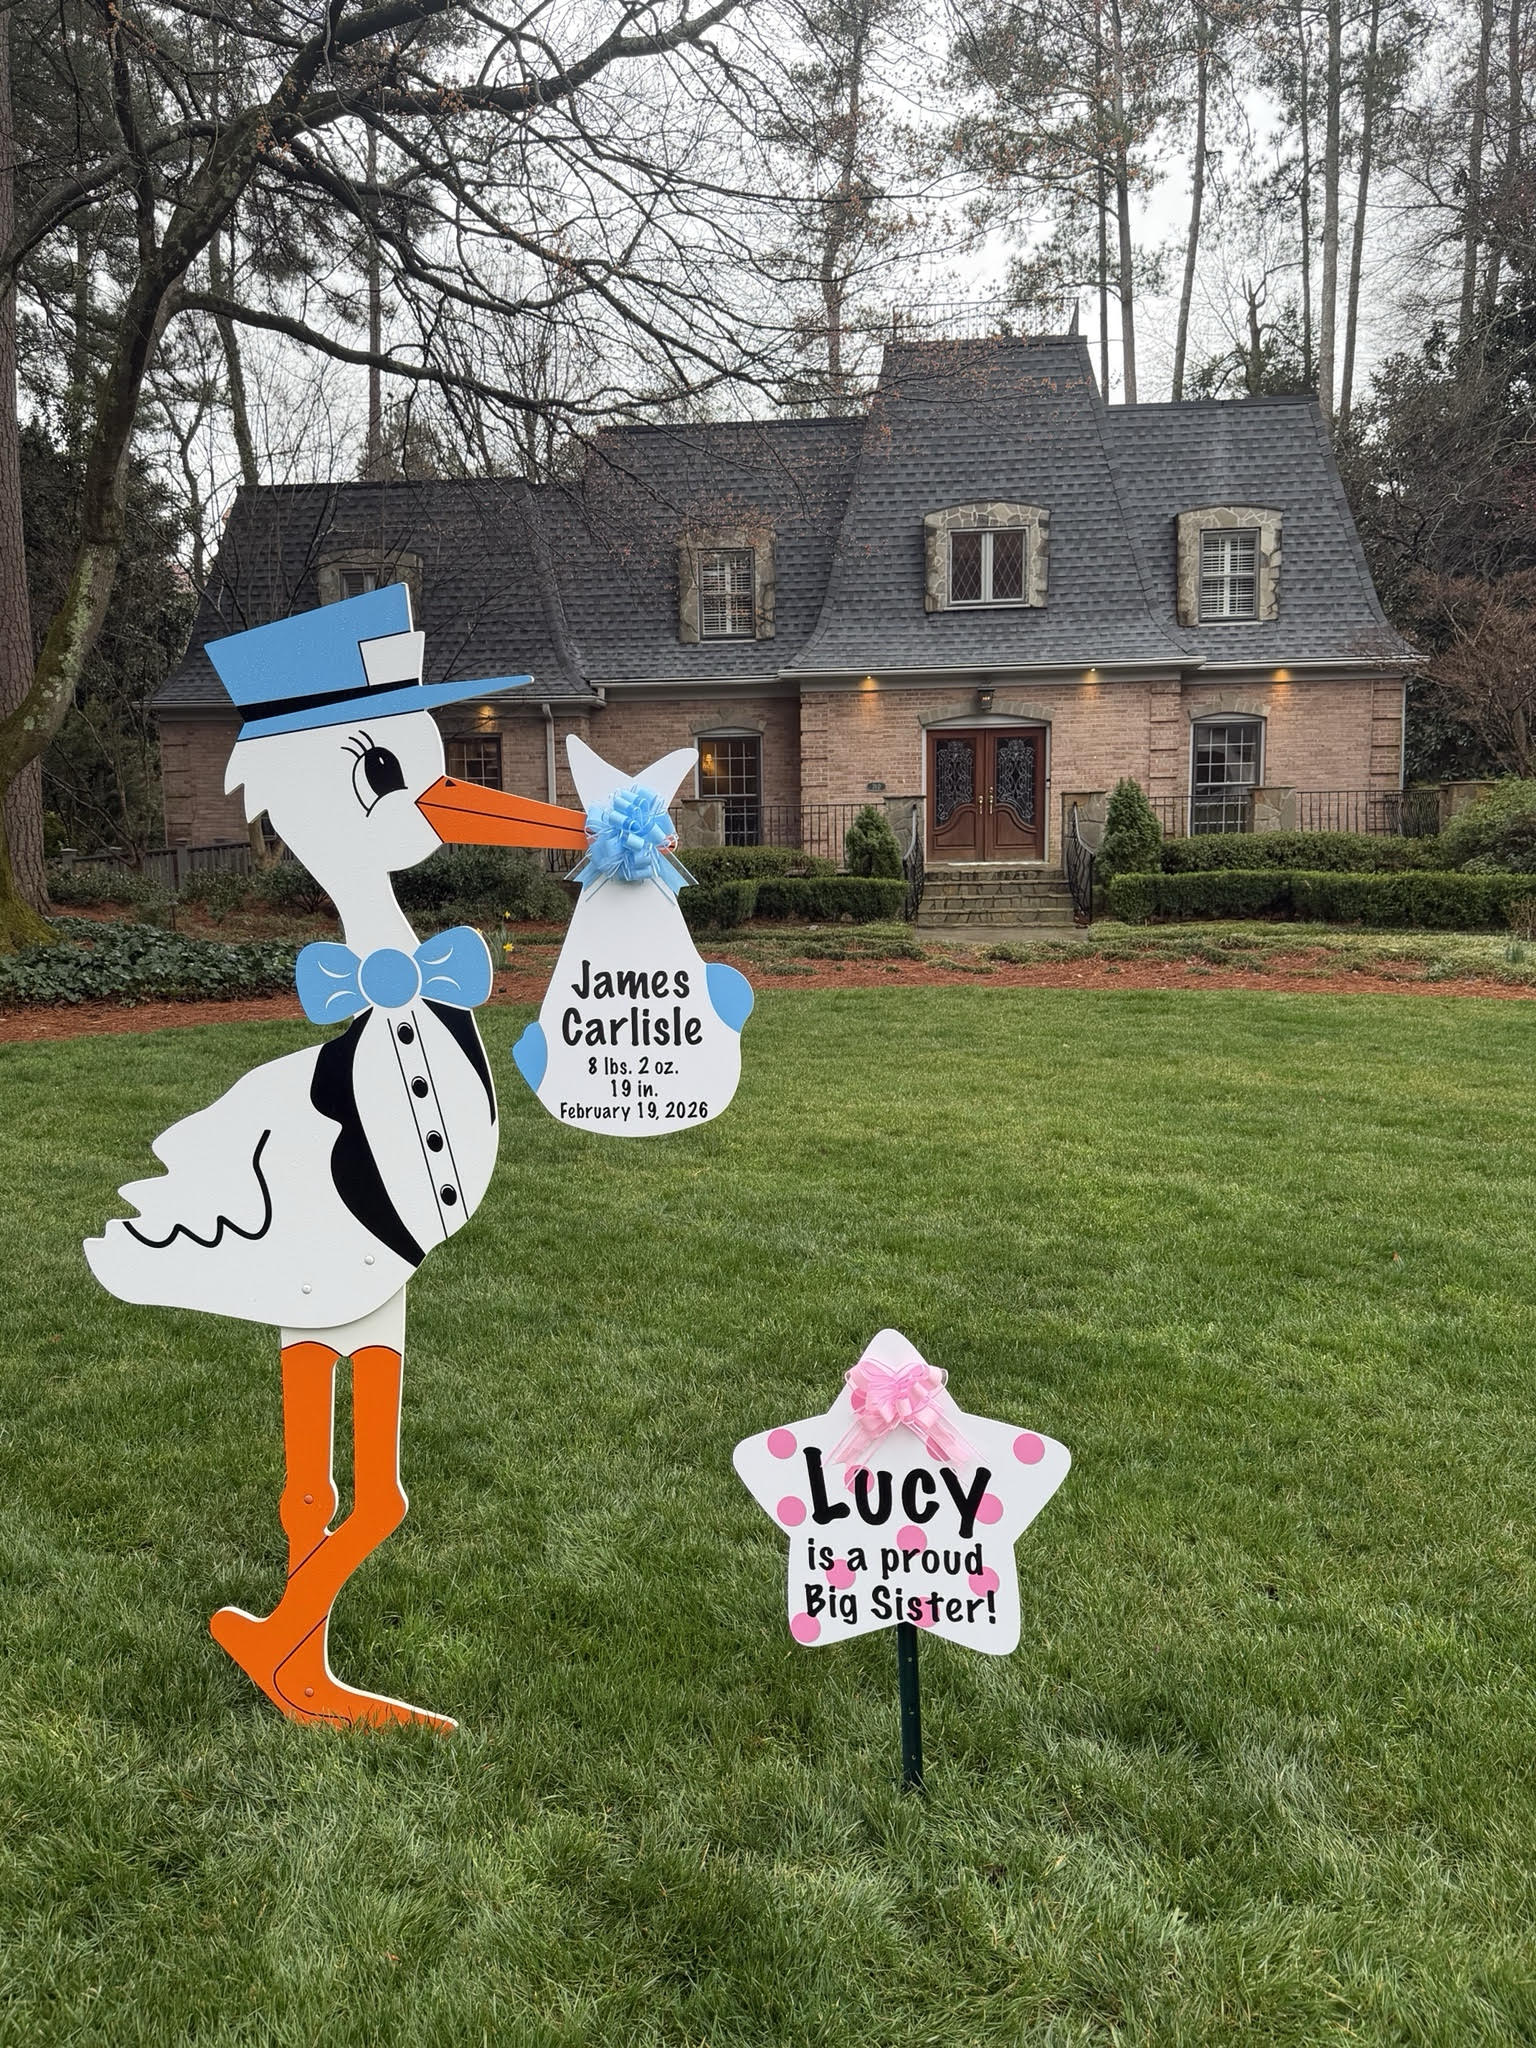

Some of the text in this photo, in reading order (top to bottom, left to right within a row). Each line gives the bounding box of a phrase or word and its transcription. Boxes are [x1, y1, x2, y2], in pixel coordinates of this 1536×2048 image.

[571, 960, 690, 999] James
[562, 1006, 703, 1046] Carlisle
[588, 1056, 679, 1075] 8 lbs. 2 oz.
[611, 1079, 658, 1098] 19 in.
[560, 1101, 708, 1121] February 19, 2026
[803, 1446, 992, 1539] LUCY
[807, 1538, 984, 1580] is a proud
[804, 1583, 996, 1624] Big Sister!
